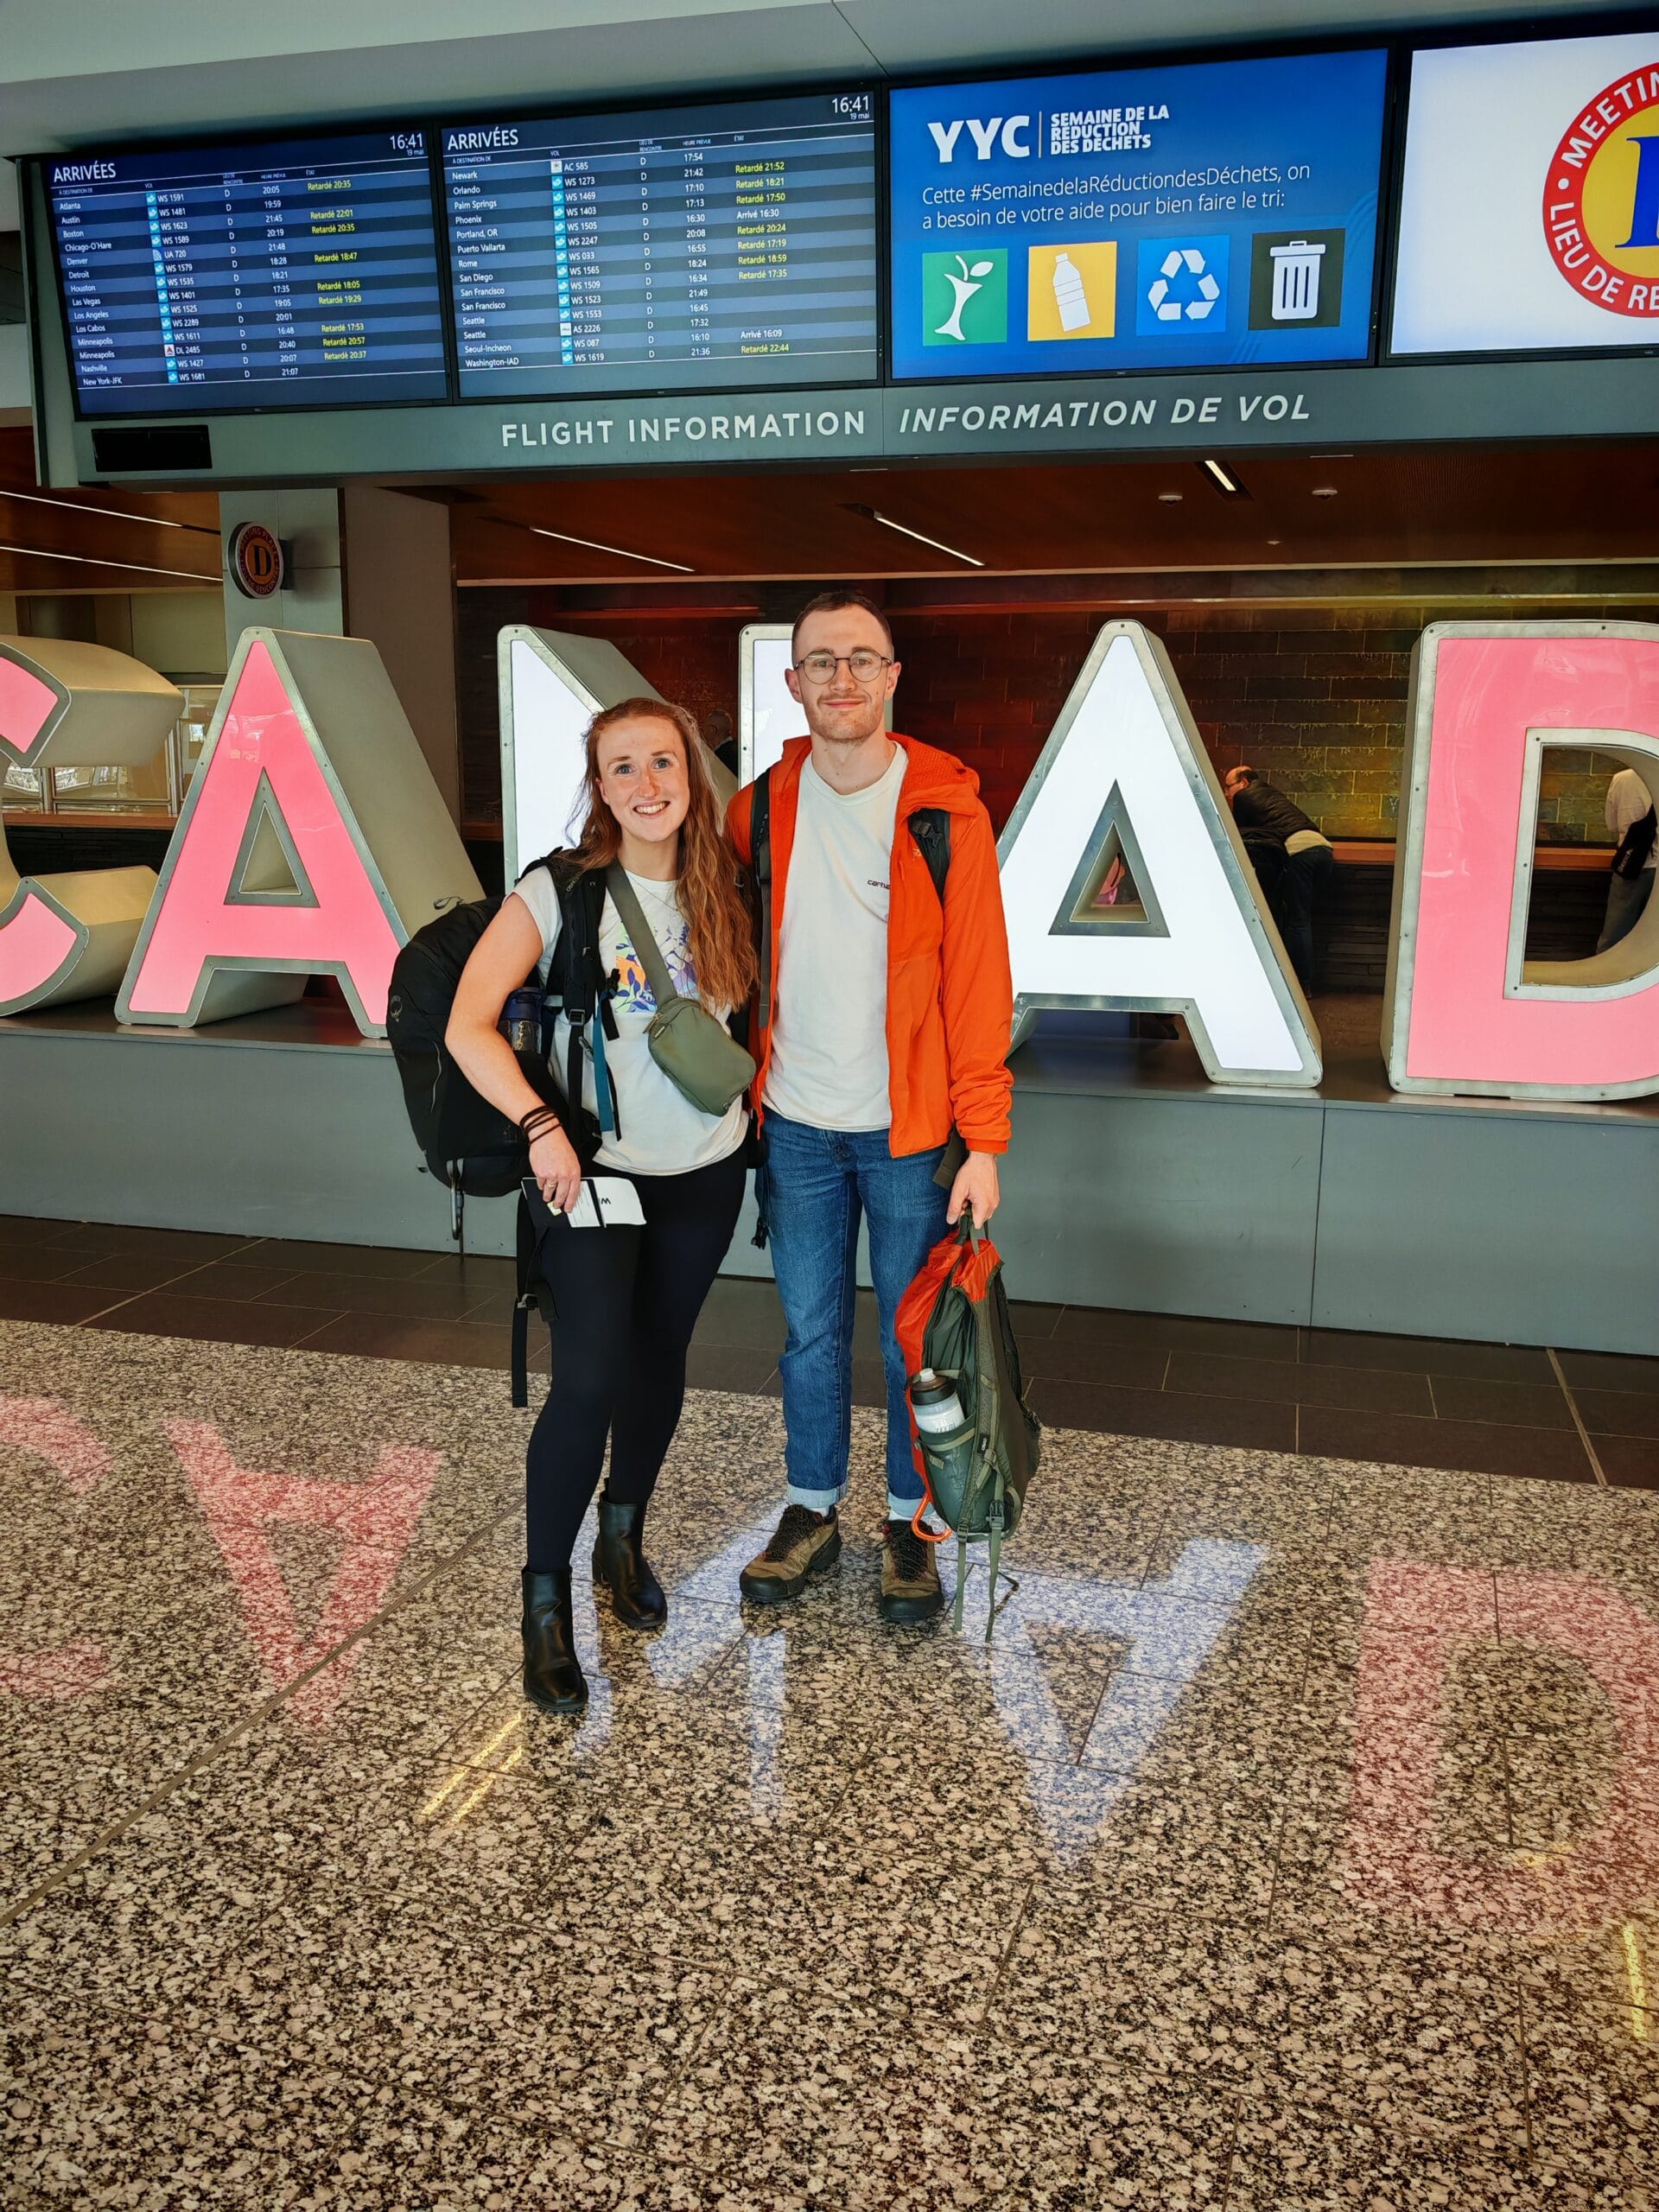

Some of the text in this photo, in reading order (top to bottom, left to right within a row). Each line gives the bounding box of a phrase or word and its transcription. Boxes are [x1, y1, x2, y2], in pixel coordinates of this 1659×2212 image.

[832, 95, 868, 113] 16:41
[858, 111, 870, 120] mai
[1051, 105, 1169, 128] SEMAINE DE LA
[390, 133, 423, 149] 16:41
[448, 126, 518, 150] ARRIVÉES
[927, 116, 1030, 163] YYC
[1051, 140, 1079, 156] DES
[684, 152, 702, 162] 17:54
[54, 160, 116, 182] ARRIVÉES
[684, 168, 703, 176] 21:42
[735, 161, 784, 173] Retardé 21:52
[452, 170, 477, 180] Newark
[308, 180, 351, 190] Retardé 20:35
[685, 183, 703, 192] 17:10
[735, 177, 784, 188] Retardé 18:21
[923, 165, 1310, 205] Cette #SemainedelaRéductiondesDéchets, on
[263, 185, 279, 194] 20:05
[453, 185, 480, 194] Orlando
[685, 198, 704, 207] 17:13
[736, 192, 785, 203] Retardé 17:50
[264, 200, 281, 208] 19:59
[472, 200, 496, 209] Springs
[923, 189, 1285, 229] a besoin de votre aide pour bien faire le tri:
[265, 213, 282, 222] 21:45
[310, 209, 353, 219] Retardé 22:01
[686, 213, 704, 222] 16:30
[736, 208, 779, 219] Arrivé 16:30
[455, 214, 481, 224] Phoenix
[267, 228, 283, 237] 20:19
[311, 223, 354, 233] Retardé 20:35
[686, 228, 705, 238] 20:08
[737, 223, 785, 234] Retardé 20:24
[269, 242, 285, 251] 21:48
[687, 244, 706, 252] 16:55
[738, 238, 786, 249] Retardé 17:19
[315, 251, 357, 262] Retardé 18:47
[1550, 201, 1591, 270] LIEU
[1580, 264, 1624, 304] DE
[688, 258, 706, 267] 18:24
[738, 254, 786, 264] Retardé 18:59
[473, 273, 493, 283] Diego
[739, 269, 786, 279] Retardé 17:35
[273, 284, 289, 293] 17:35
[317, 280, 359, 289] Retardé 18:05
[689, 289, 708, 297] 21:49
[318, 294, 361, 304] Retardé 19:29
[475, 301, 505, 309] Francisco
[690, 303, 708, 312] 16:45
[86, 310, 109, 320] Angeles
[462, 316, 485, 325] Seattle
[321, 323, 346, 332] Retardé
[463, 330, 486, 339] Seattle
[741, 328, 782, 338] Arrivé 16:09
[78, 337, 112, 346] Minneapolis
[322, 336, 365, 346] Retardé 20:57
[465, 344, 512, 353] Seoul-Incheon
[691, 347, 710, 356] 21:36
[741, 343, 789, 353] Retardé 22:44
[79, 350, 115, 359] Minneapolis
[280, 353, 296, 362] 20:07
[324, 350, 365, 359] Retardé 20:37
[465, 357, 518, 367] Washington-IAD
[899, 394, 1310, 433] INFORMATION DE VOL
[501, 410, 864, 448] FLIGHT INFORMATION
[253, 544, 271, 577] D
